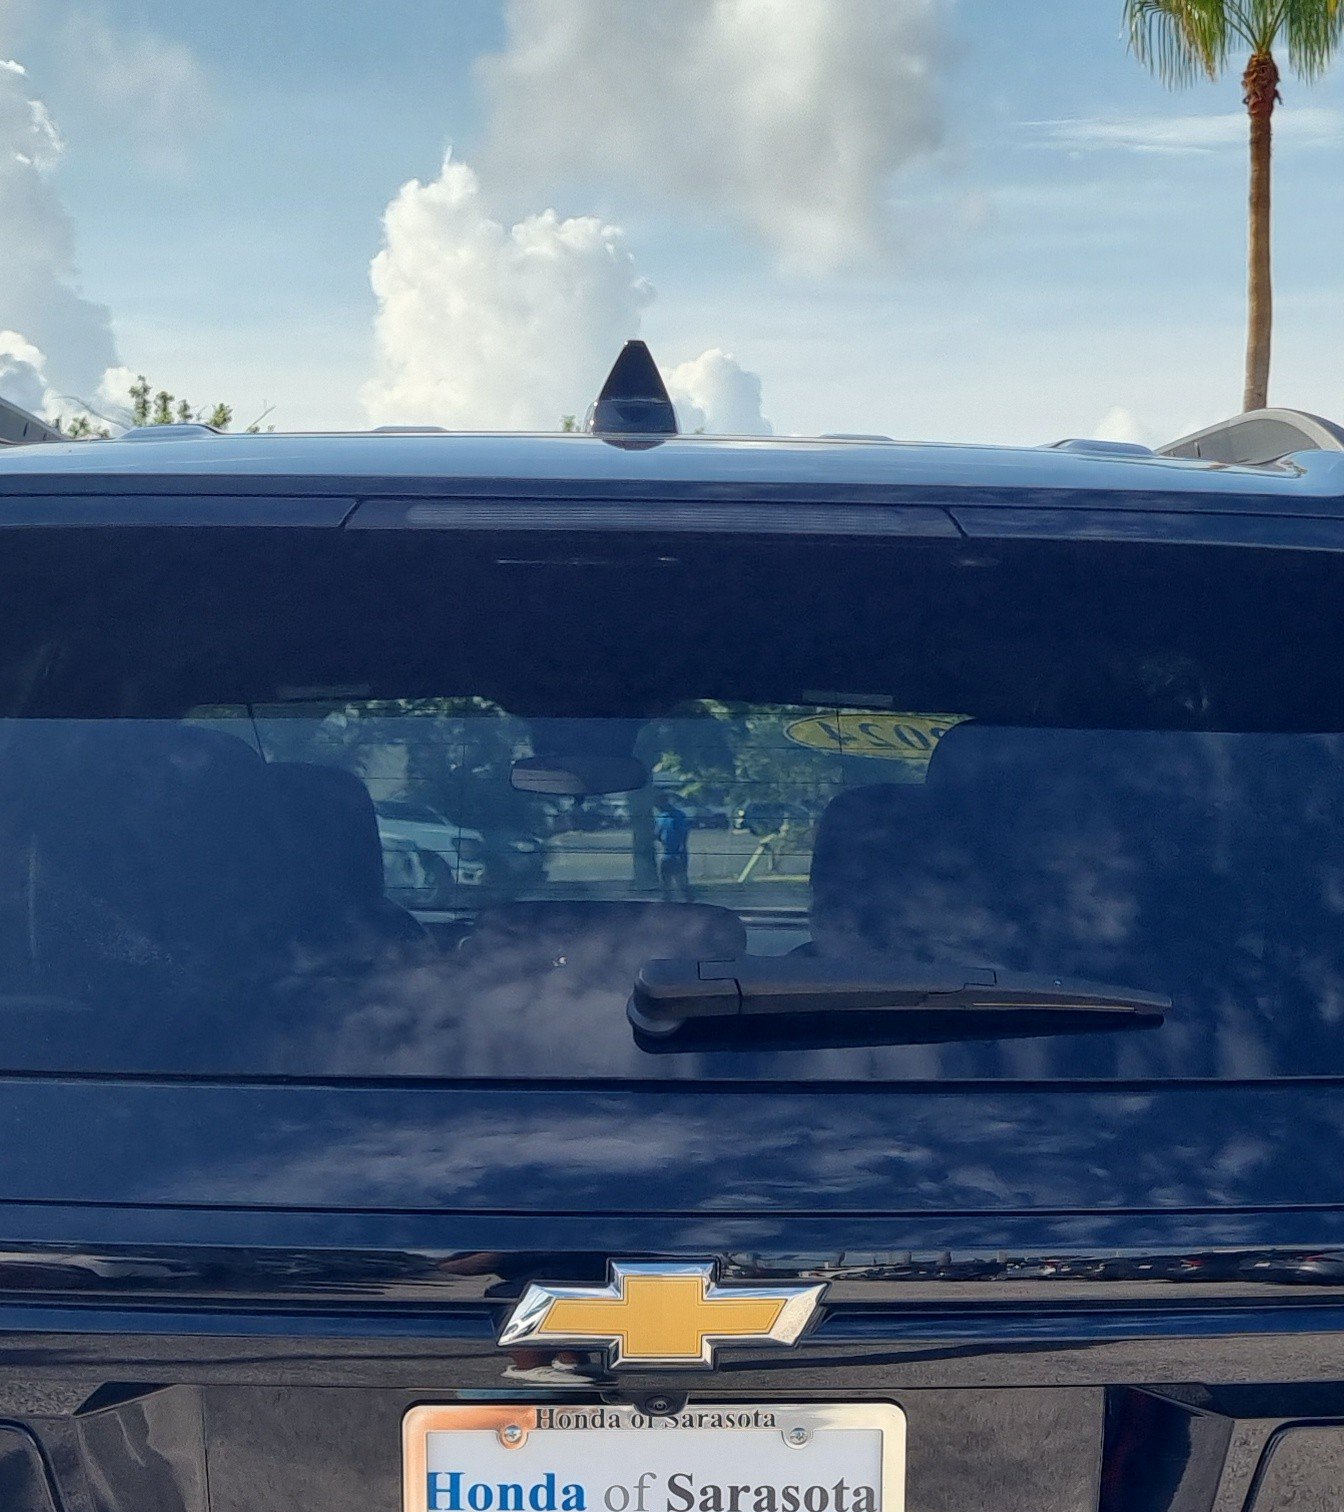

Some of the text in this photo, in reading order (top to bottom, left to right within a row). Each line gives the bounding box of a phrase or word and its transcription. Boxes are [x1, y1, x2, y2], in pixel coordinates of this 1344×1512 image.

[535, 1408, 621, 1429] Honda
[427, 1472, 878, 1512] Honda of Sarasota
